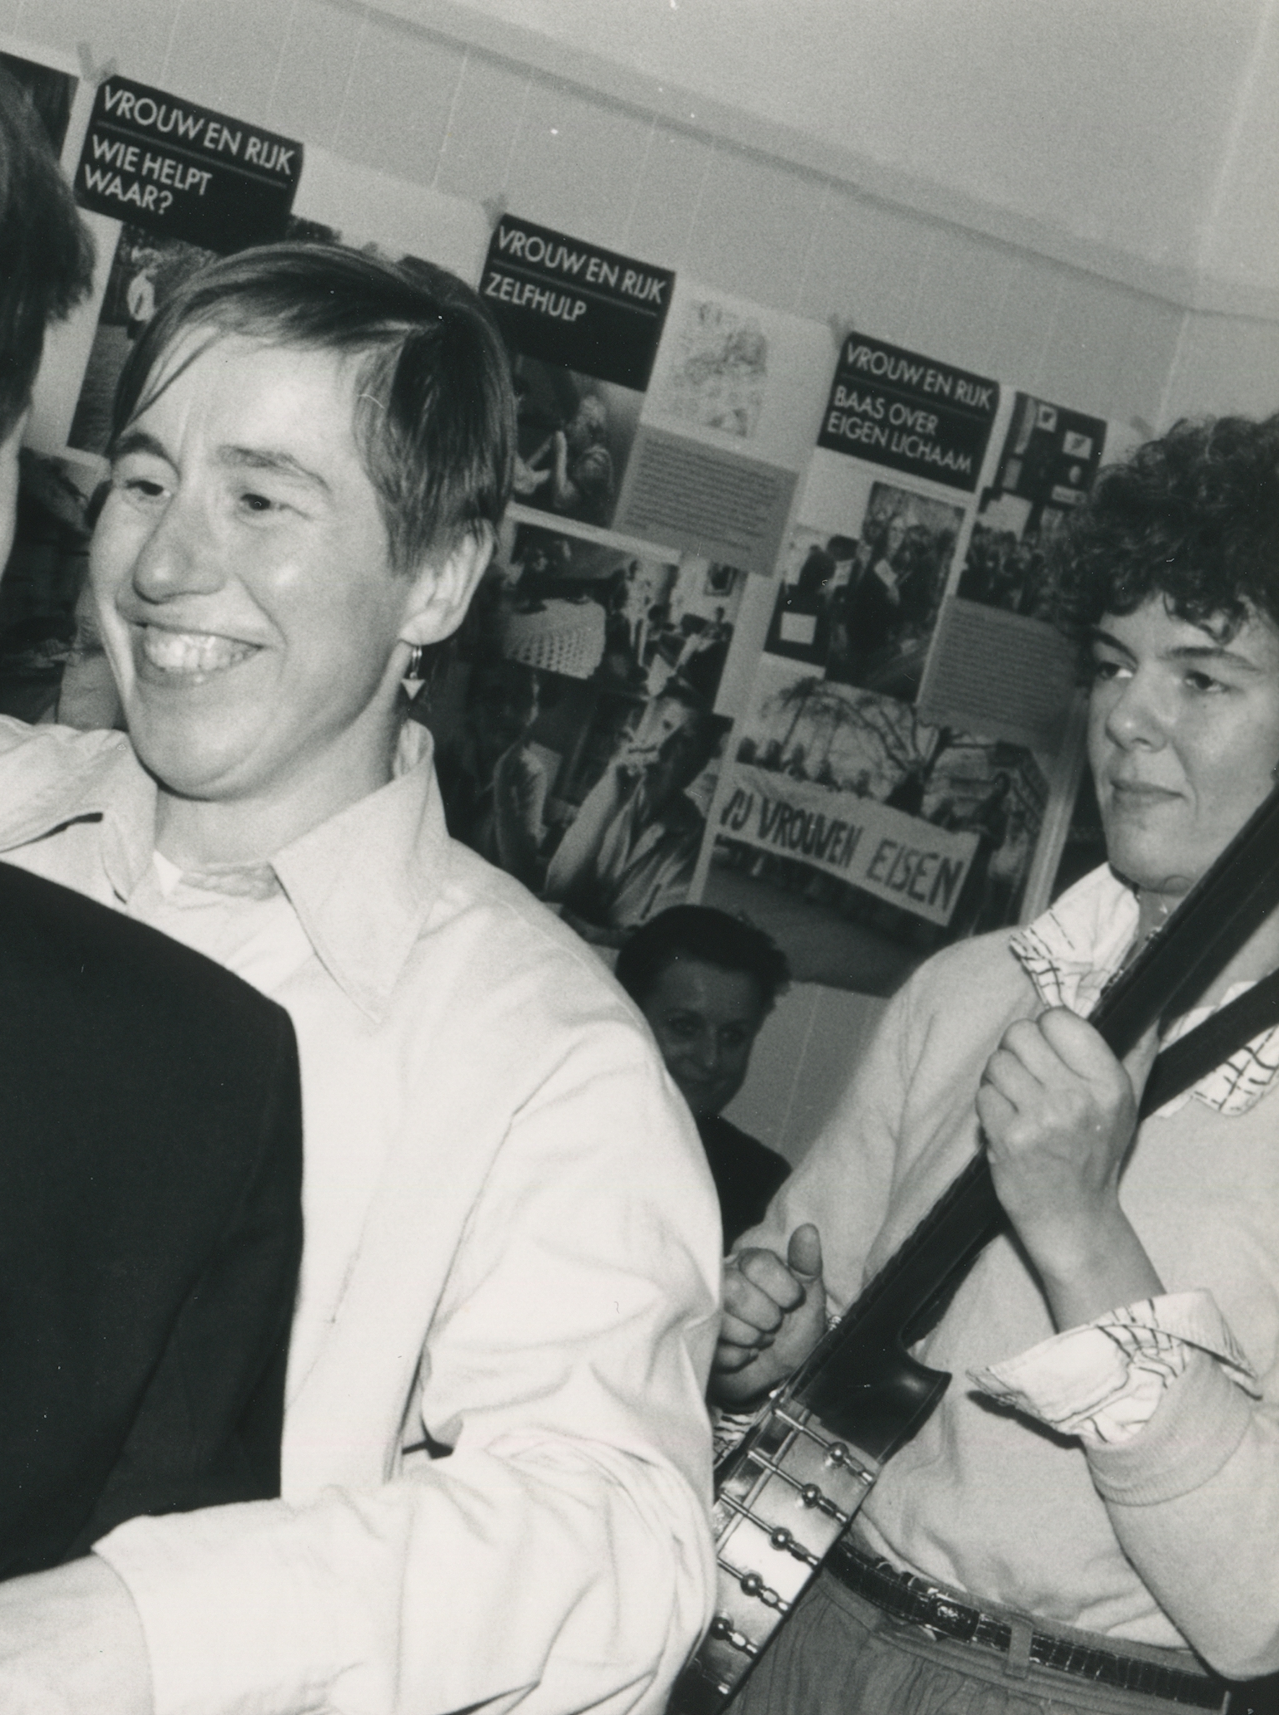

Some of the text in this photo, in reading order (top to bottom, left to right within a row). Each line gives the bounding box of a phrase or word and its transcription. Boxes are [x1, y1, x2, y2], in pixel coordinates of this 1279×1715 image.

[104, 85, 295, 175] VROUW EN RIJK
[85, 164, 173, 215] WAAR?
[92, 135, 213, 195] WIE HELPT
[498, 225, 667, 304] VROUW EN RIJK
[485, 272, 587, 322] ZELFHULP
[846, 342, 993, 410] VROUW EN RIJK
[834, 385, 939, 435] BAAS OVER
[827, 411, 974, 474] EIGEN LICHAAM
[866, 837, 964, 912] EISEN
